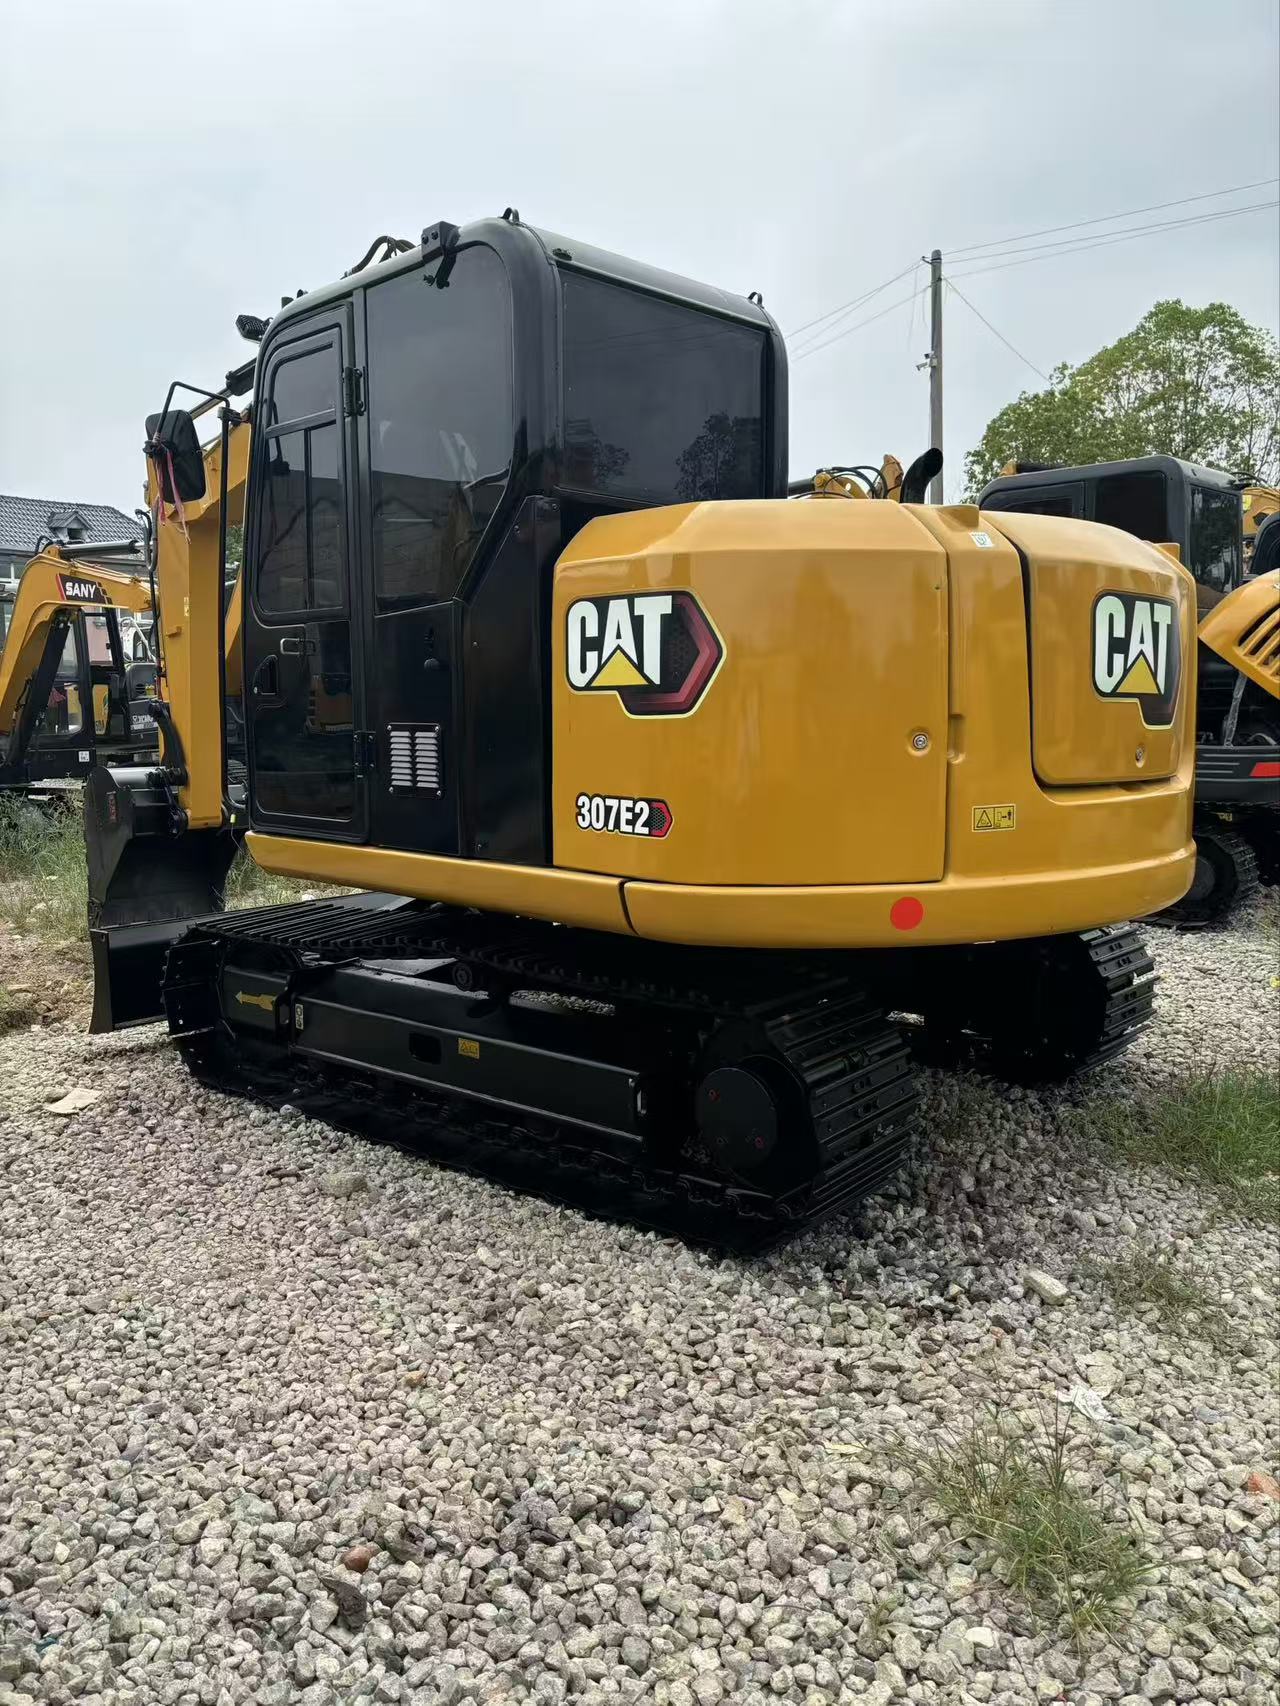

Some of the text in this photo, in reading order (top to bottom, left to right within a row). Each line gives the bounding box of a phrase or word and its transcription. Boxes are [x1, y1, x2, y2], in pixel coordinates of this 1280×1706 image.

[65, 581, 96, 599] SANY
[567, 595, 673, 688] CAT
[1094, 595, 1172, 695] CAT
[577, 795, 650, 835] 307E2
